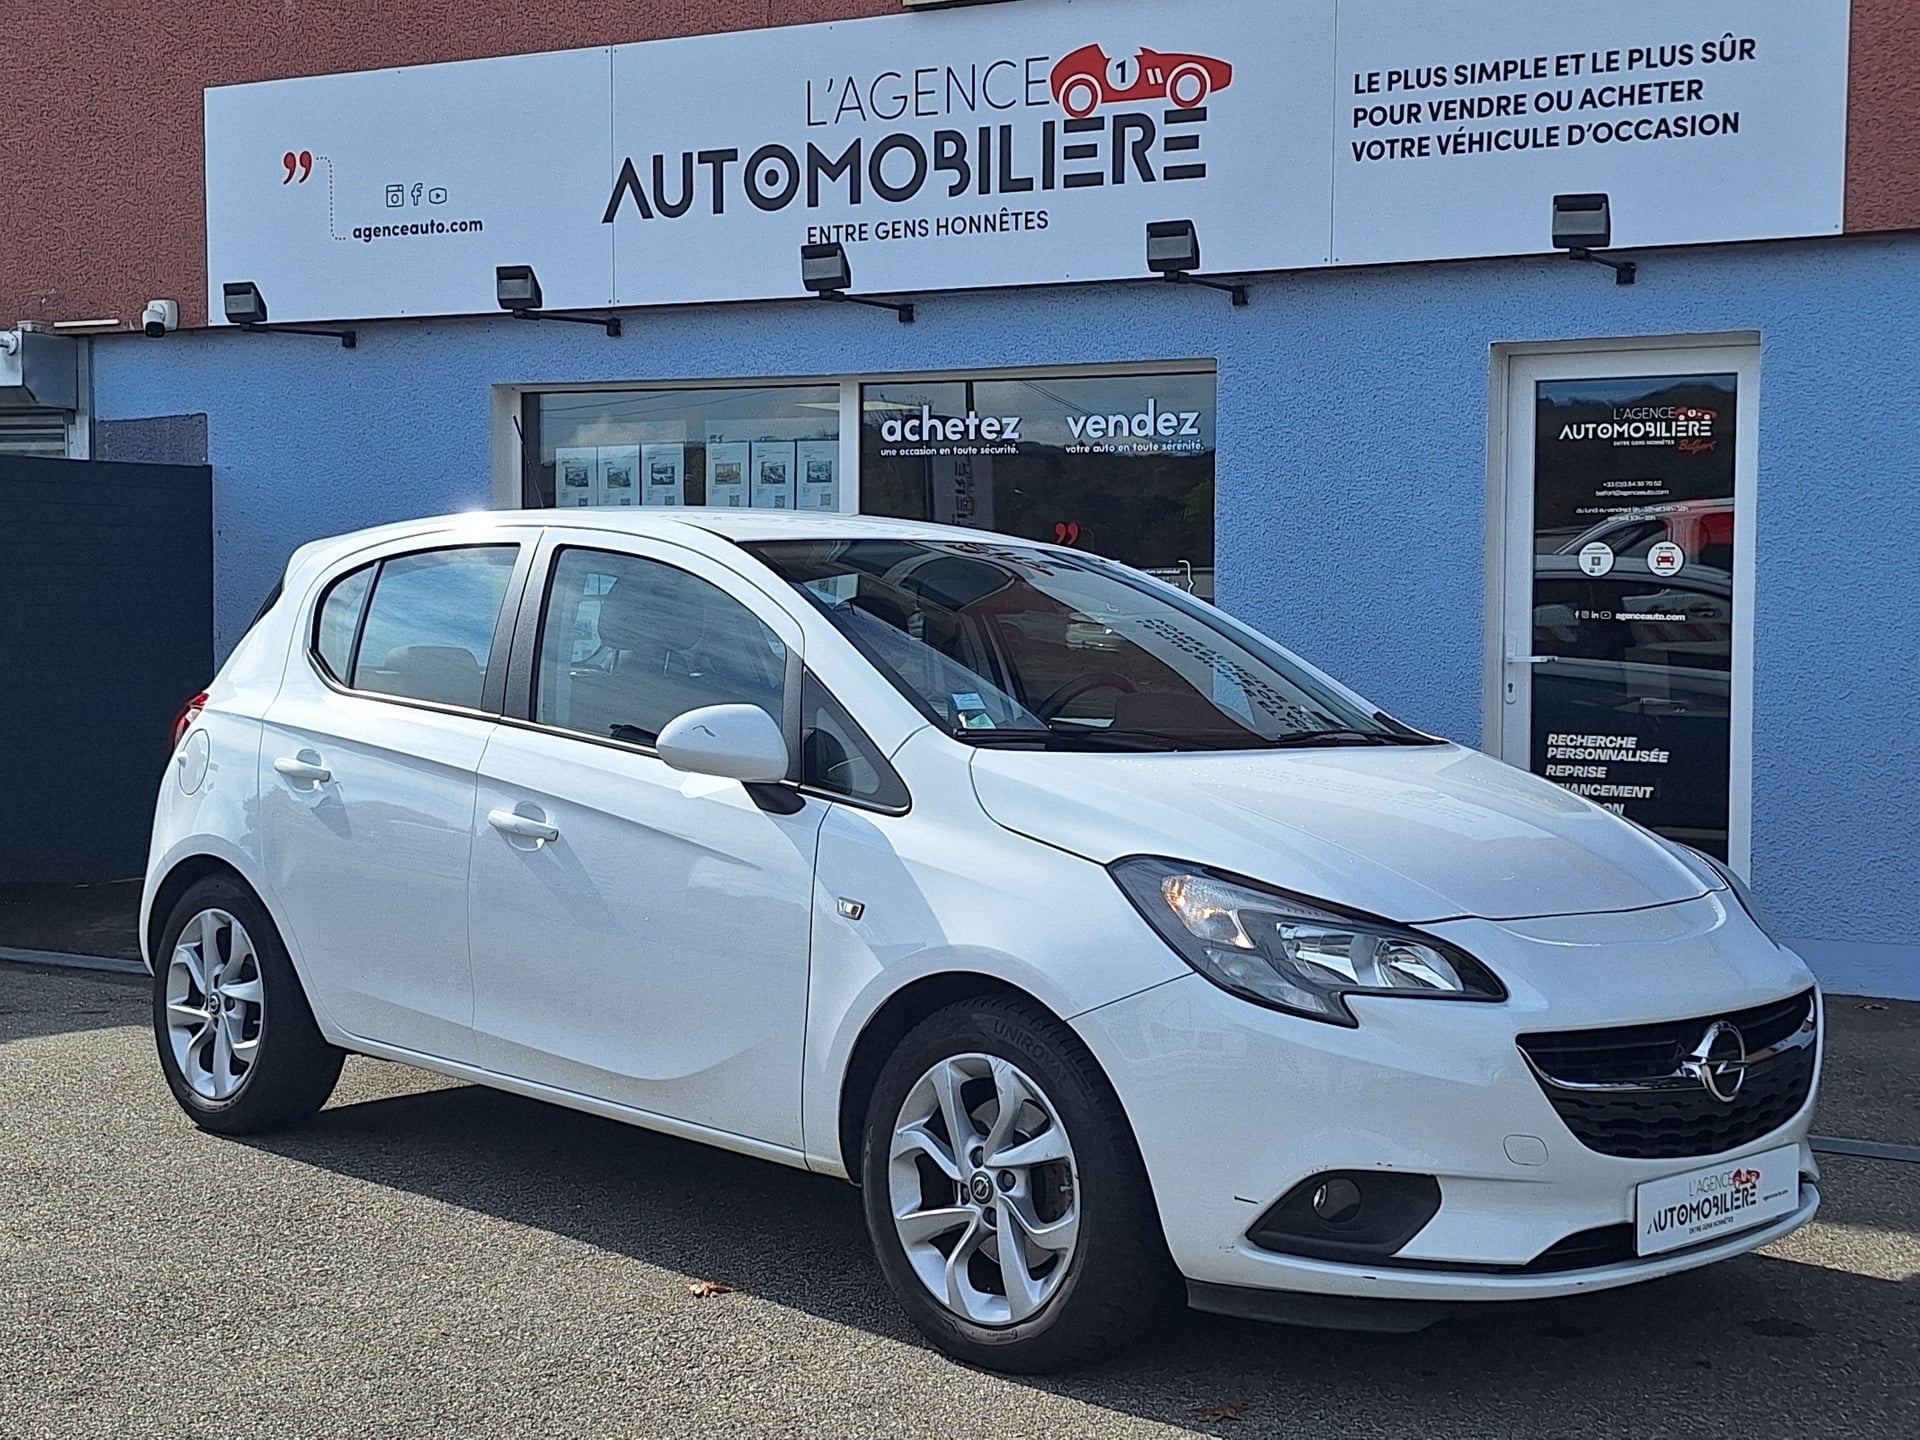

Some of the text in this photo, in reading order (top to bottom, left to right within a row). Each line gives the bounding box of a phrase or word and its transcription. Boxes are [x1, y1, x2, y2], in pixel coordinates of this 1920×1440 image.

[1354, 33, 1756, 95] LE PLUS SIMPLE ET LE PLUS SÛR
[806, 56, 1050, 127] L'AGENCE
[1353, 79, 1703, 128] POUR VENDRE OU ACHETER
[1352, 112, 1739, 162] VOTRE VÉHICULE D'OCCASION
[353, 219, 483, 243] agenceauto.com
[807, 207, 1049, 245] ENTRE GENS HONNÊTES
[881, 404, 1020, 442] achetez
[1066, 398, 1199, 438] vendez
[1613, 406, 1676, 420] L'AGENCE
[880, 448, 897, 456] une
[900, 445, 936, 456] occasion
[939, 447, 950, 455] en
[953, 445, 977, 455] toute
[1065, 444, 1090, 453] votre
[1093, 443, 1115, 453] auto
[1133, 442, 1159, 451] toute
[1547, 733, 1638, 748] RECHERCHE
[1547, 747, 1669, 763] PERSONNALISÉE
[1545, 765, 1608, 778] REPRISE
[1557, 783, 1654, 798] ANCEMENT
